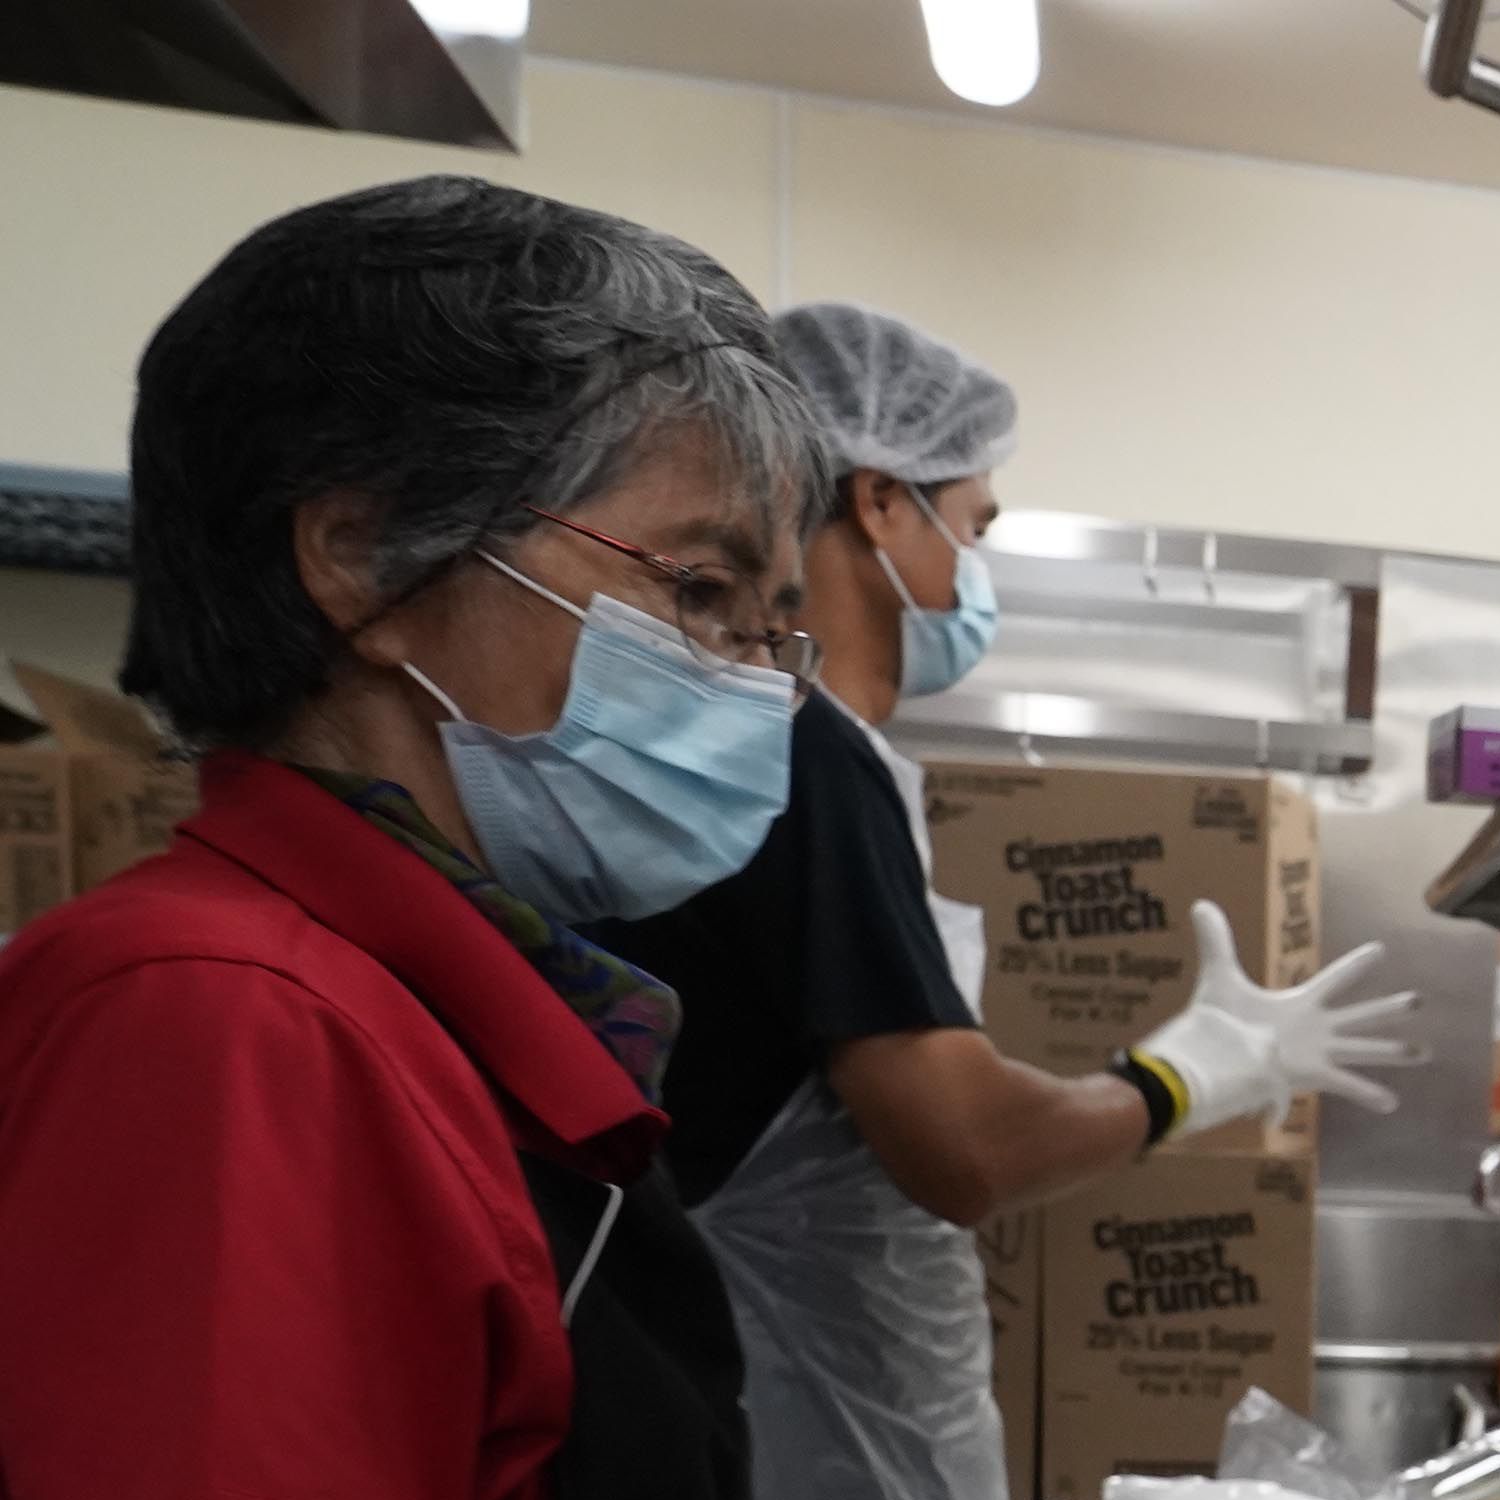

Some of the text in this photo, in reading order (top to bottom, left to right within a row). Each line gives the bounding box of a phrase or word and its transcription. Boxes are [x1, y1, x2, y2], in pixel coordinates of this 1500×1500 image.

[1005, 834, 1164, 873] Cinnamon
[1037, 866, 1138, 901] Toast
[1017, 889, 1167, 942] Crunch
[1094, 1212, 1256, 1250] Cinnamon
[1124, 1242, 1228, 1281] Toast
[1106, 1264, 1261, 1319] Crunch
